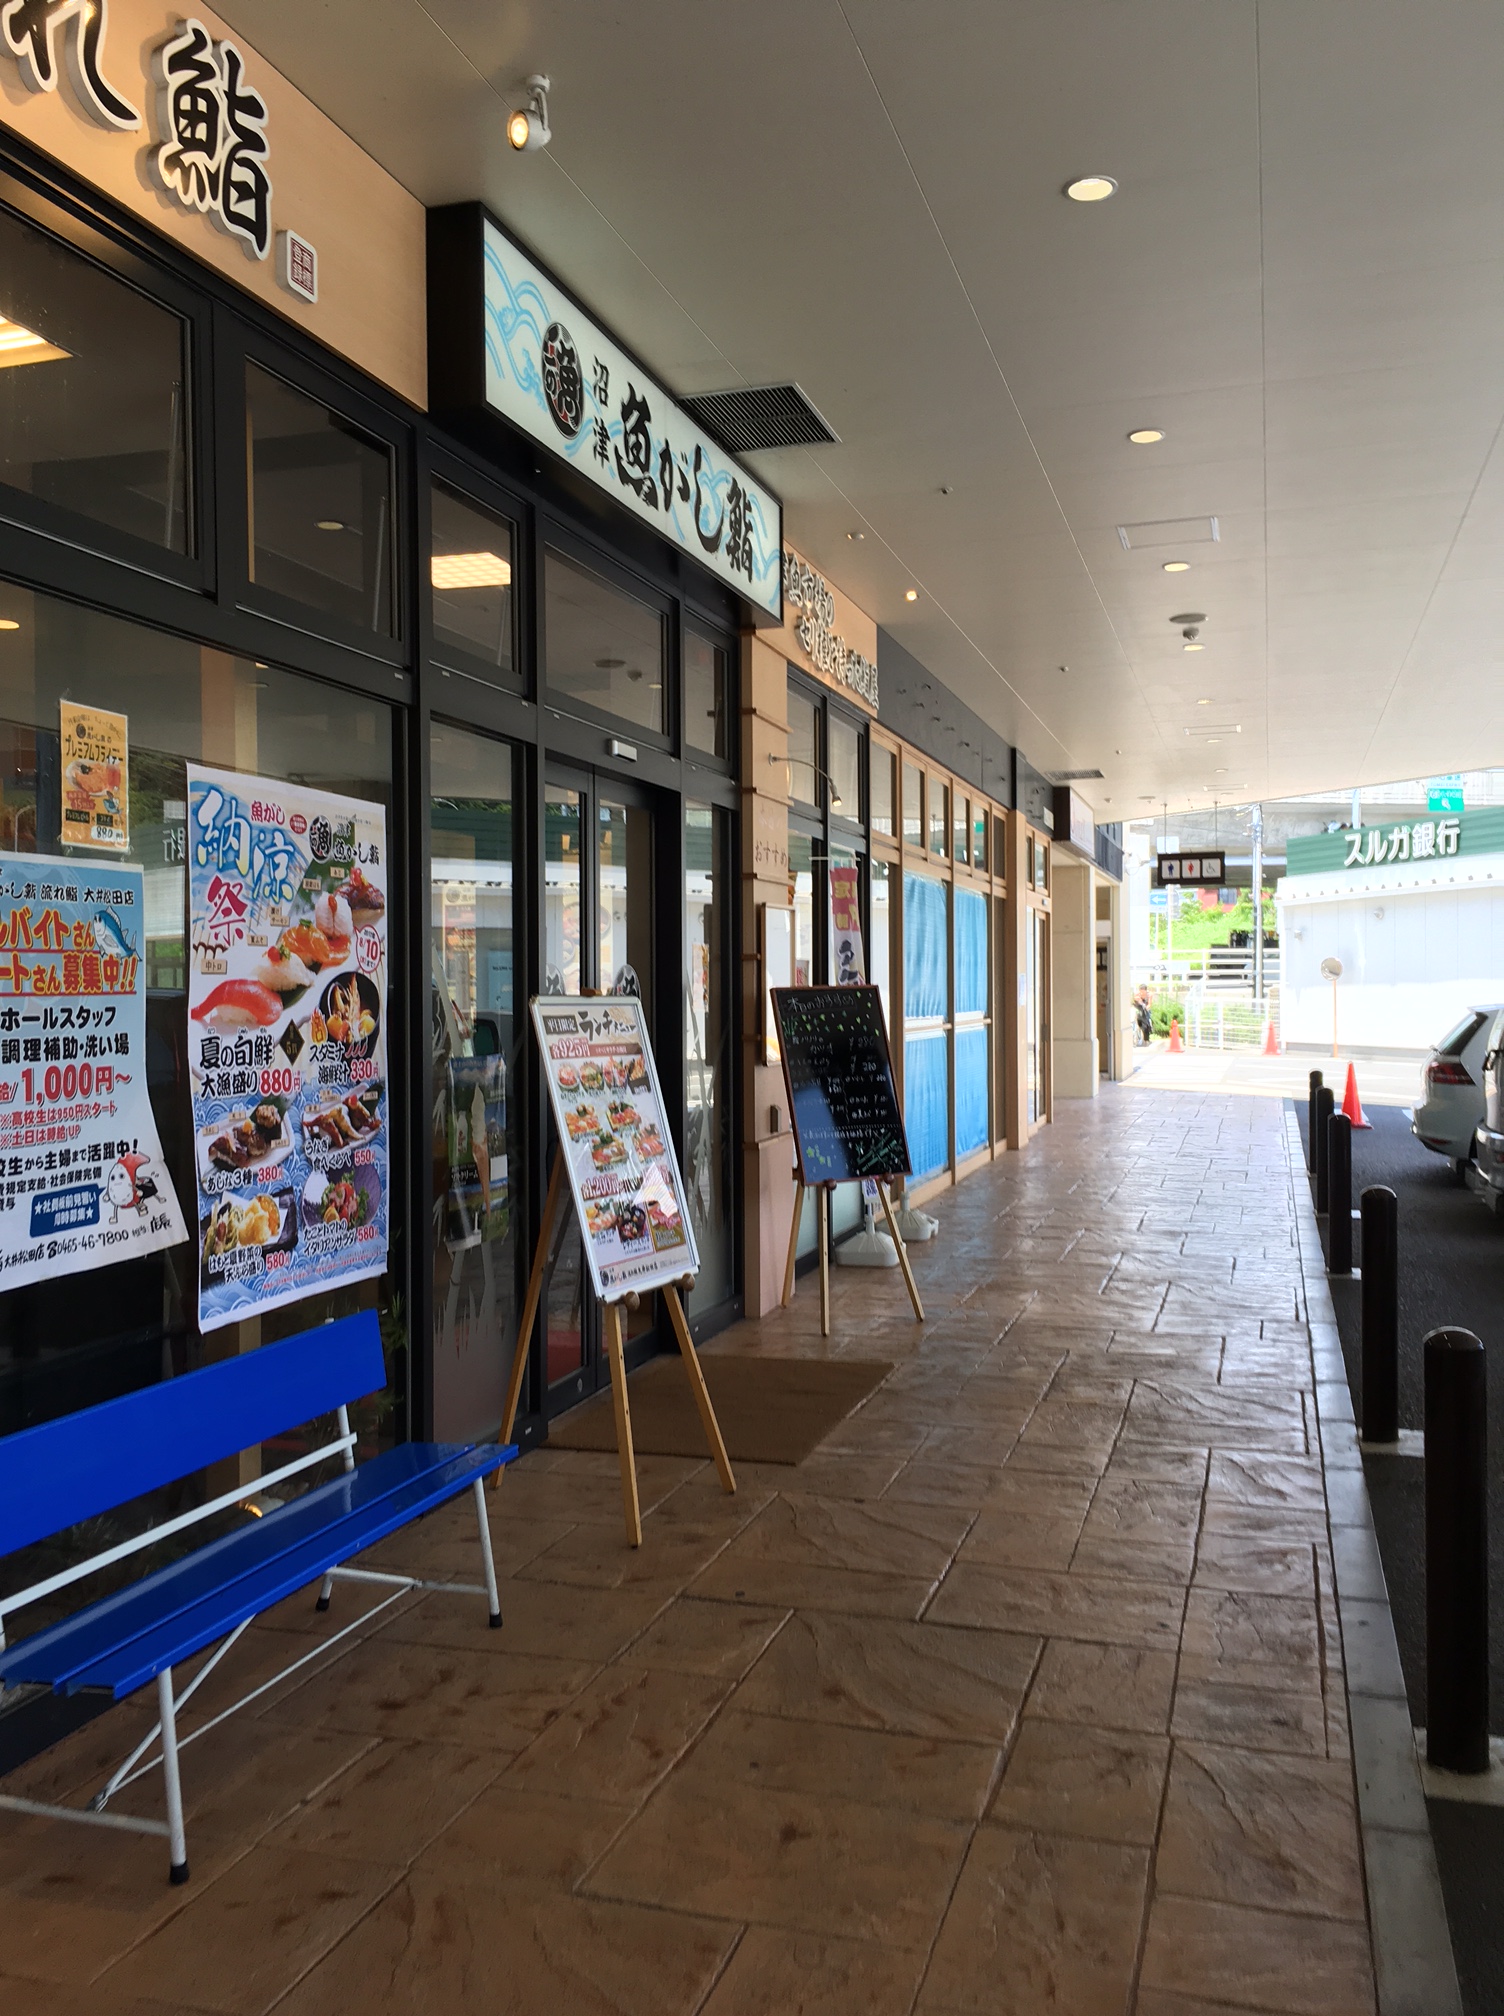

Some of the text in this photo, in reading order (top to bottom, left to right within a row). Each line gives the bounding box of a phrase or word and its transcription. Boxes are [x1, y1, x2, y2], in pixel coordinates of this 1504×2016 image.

[592, 354, 612, 468] 沼津
[65, 735, 124, 765] プレミアムフライデー
[250, 799, 286, 826] 魚がし
[196, 788, 295, 905] 納涼
[754, 841, 787, 868] おすすめ
[1344, 818, 1461, 867] スルガ銀行
[40, 883, 78, 902] 流れ鮨
[83, 887, 134, 905] 大井松田店
[207, 874, 249, 948] 祭
[205, 961, 222, 973] 中トロ
[1, 1006, 116, 1031] ホールスタッフ
[2, 1033, 130, 1064] 調理補助・洗い場
[200, 1034, 274, 1069] 夏の旬鮮
[309, 1042, 345, 1063] スタミナ
[200, 1071, 258, 1099] 大漁盛り
[318, 1063, 351, 1085] 海鮮汁
[57, 1229, 129, 1255] 0465-46-7800
